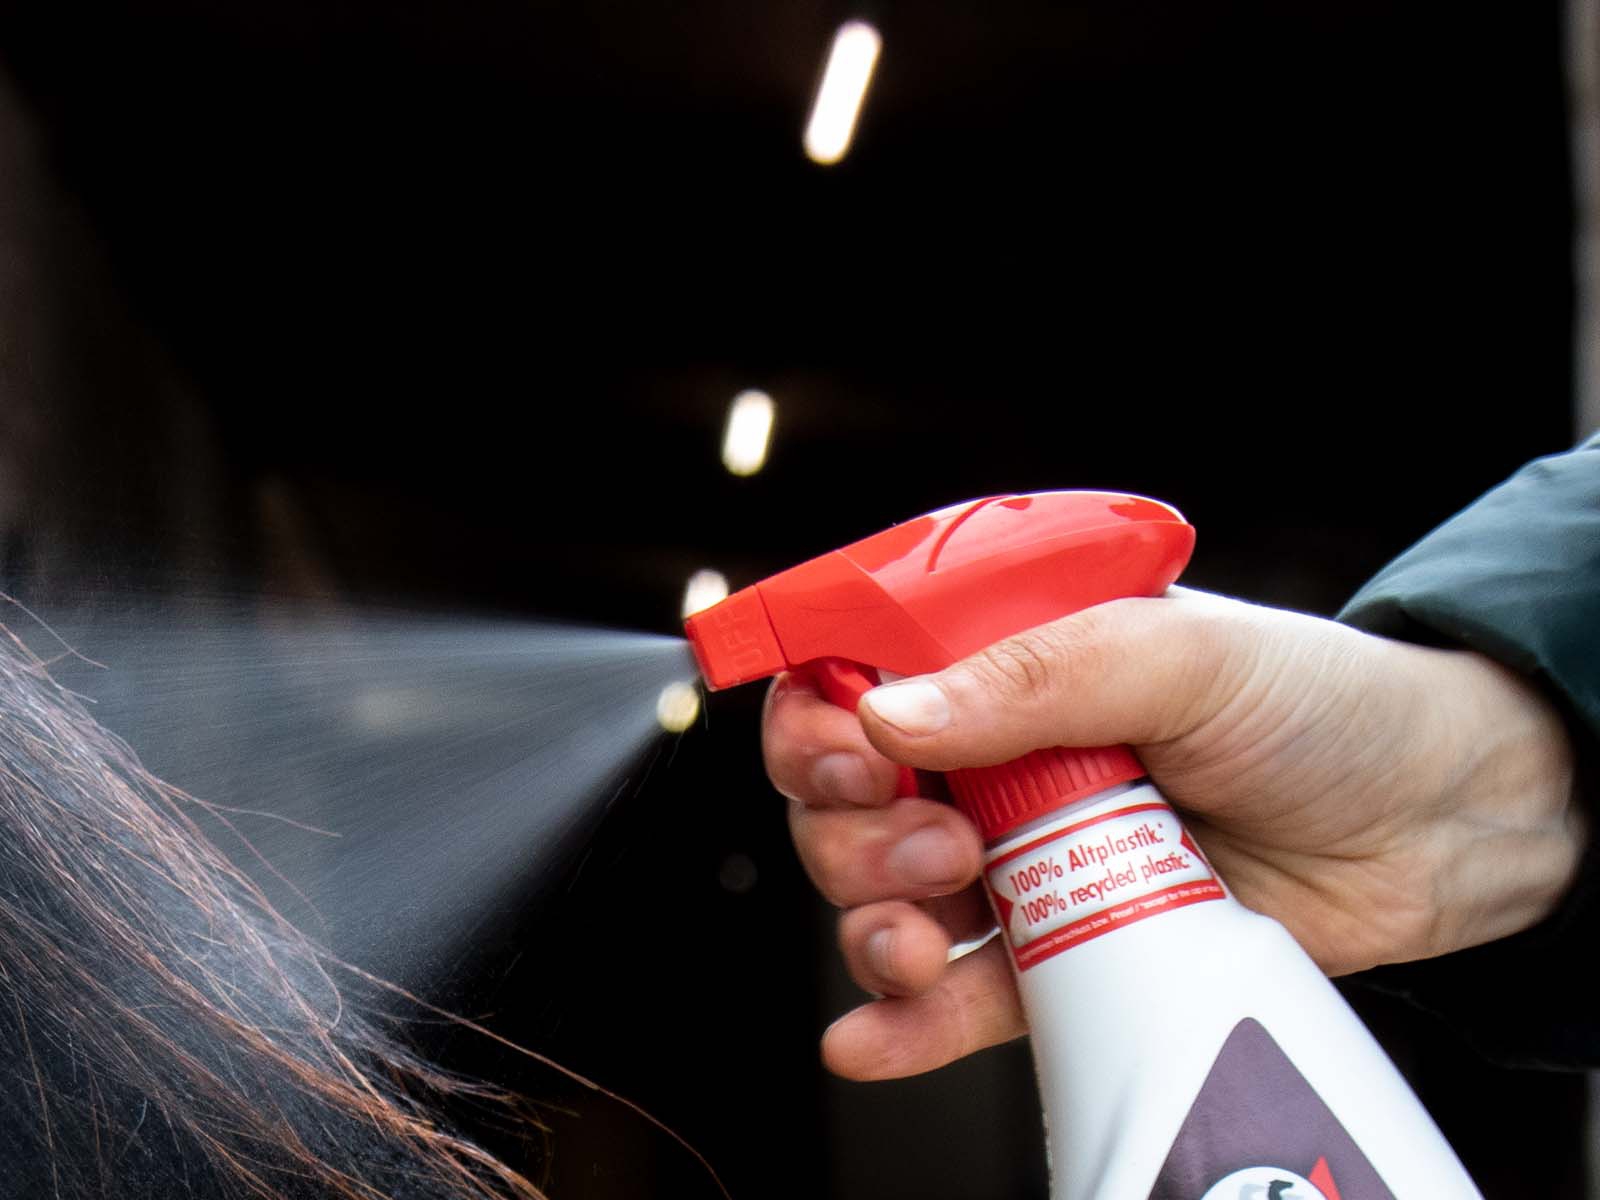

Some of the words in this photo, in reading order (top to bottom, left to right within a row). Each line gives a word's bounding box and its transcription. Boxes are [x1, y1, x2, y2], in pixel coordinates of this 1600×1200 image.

[1009, 857, 1063, 896] 100%
[1020, 890, 1067, 926] 100%
[1069, 862, 1137, 905] recycled
